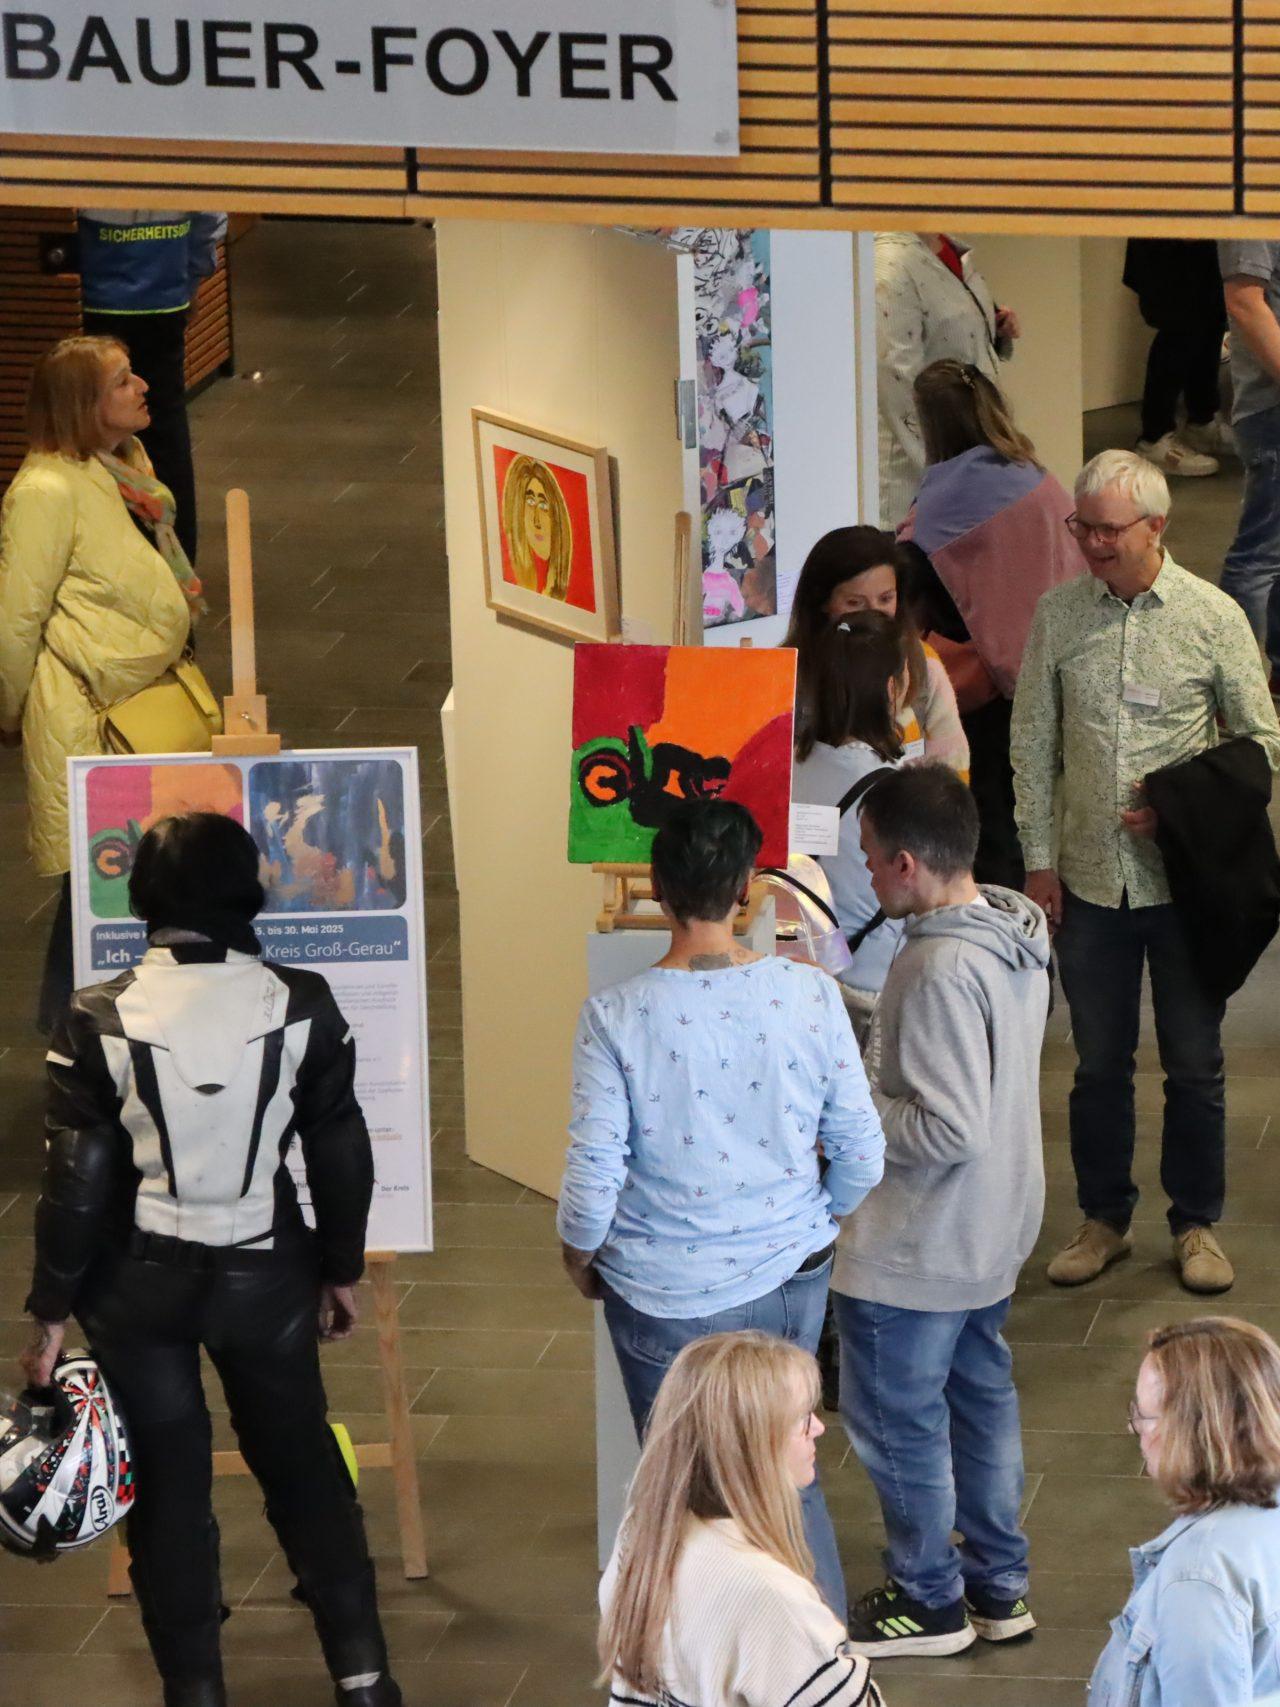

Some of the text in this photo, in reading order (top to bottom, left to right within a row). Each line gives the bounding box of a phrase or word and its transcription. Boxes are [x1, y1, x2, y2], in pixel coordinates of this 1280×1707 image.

[3, 12, 679, 102] BAUER-FOYER
[96, 929, 141, 941] Inklusive
[268, 925, 283, 936] bis
[284, 925, 298, 936] 30.
[302, 924, 319, 935] Mai
[320, 924, 344, 935] 2025
[265, 943, 301, 959] Kreis
